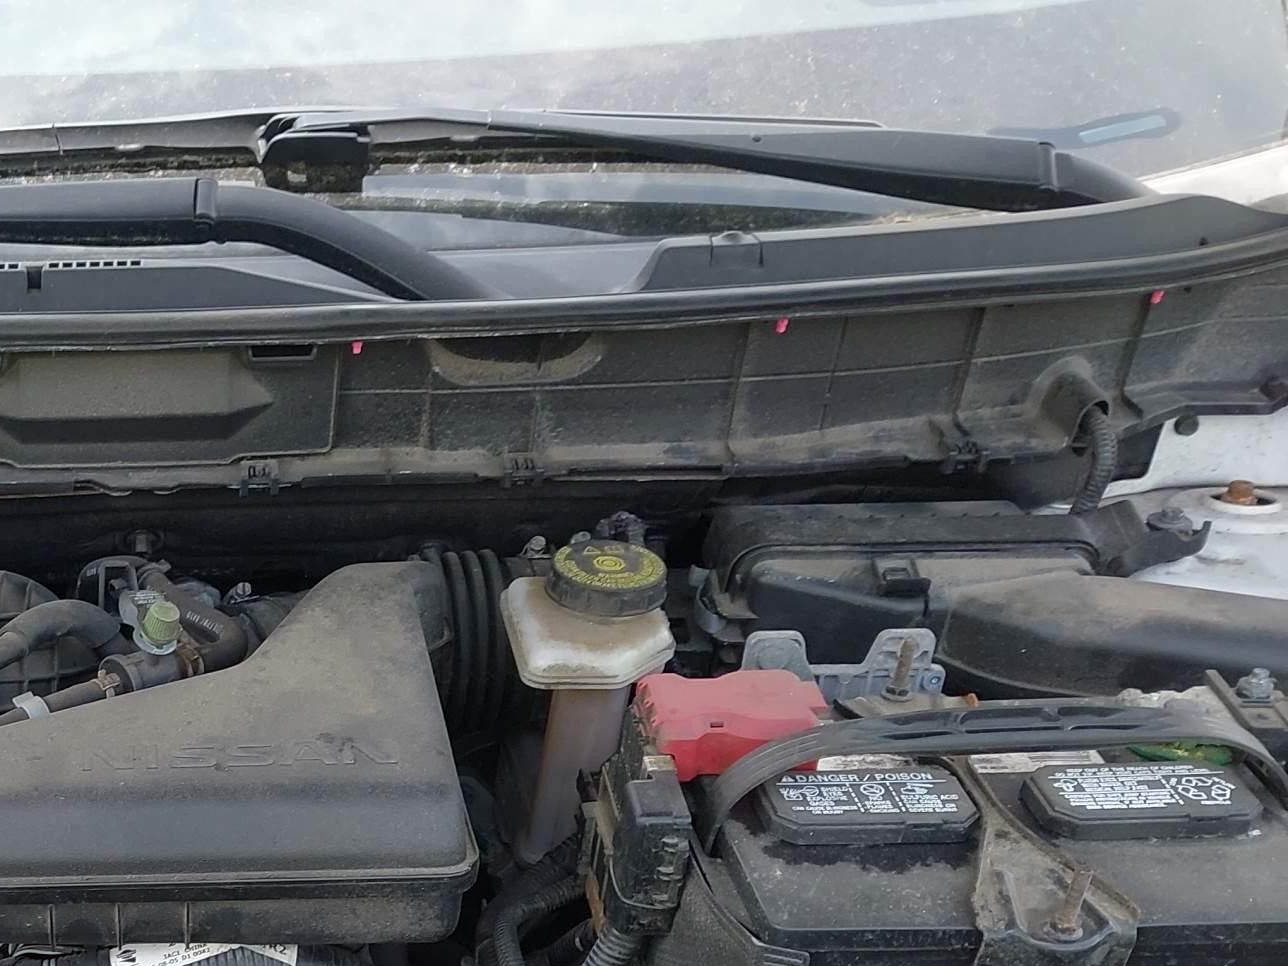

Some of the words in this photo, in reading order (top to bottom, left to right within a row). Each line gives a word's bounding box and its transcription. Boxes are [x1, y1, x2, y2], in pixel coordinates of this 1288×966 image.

[796, 774, 859, 782] DANGER
[863, 773, 870, 781] /
[874, 772, 932, 781] POISON
